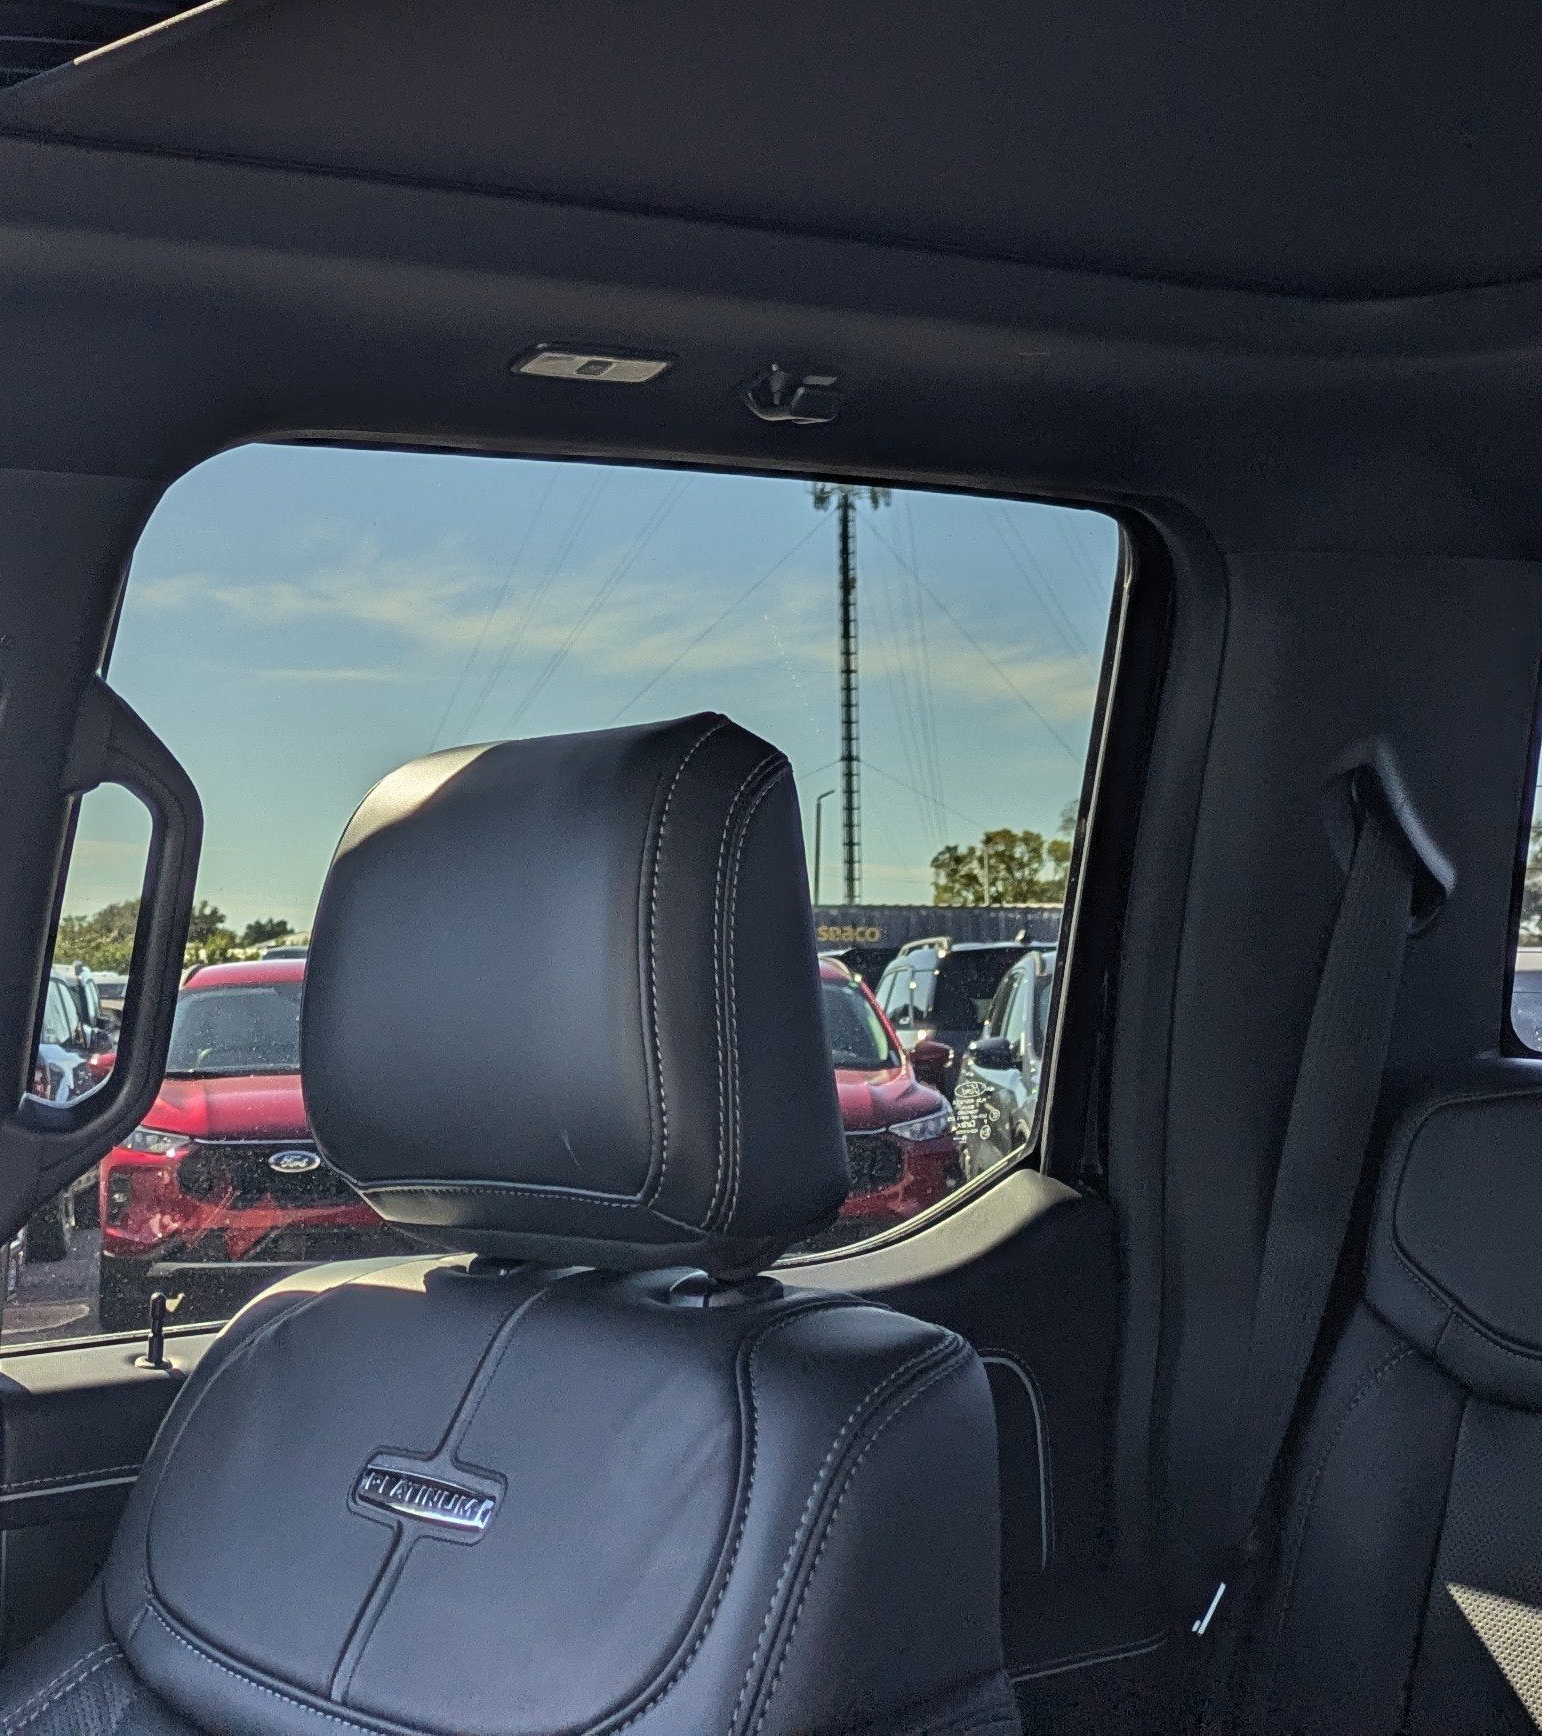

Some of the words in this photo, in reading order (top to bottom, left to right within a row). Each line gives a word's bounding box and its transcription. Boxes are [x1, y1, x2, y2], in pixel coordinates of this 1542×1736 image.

[817, 924, 881, 942] seaco
[275, 1153, 314, 1170] Ford
[363, 1471, 479, 1517] PLATINUM
